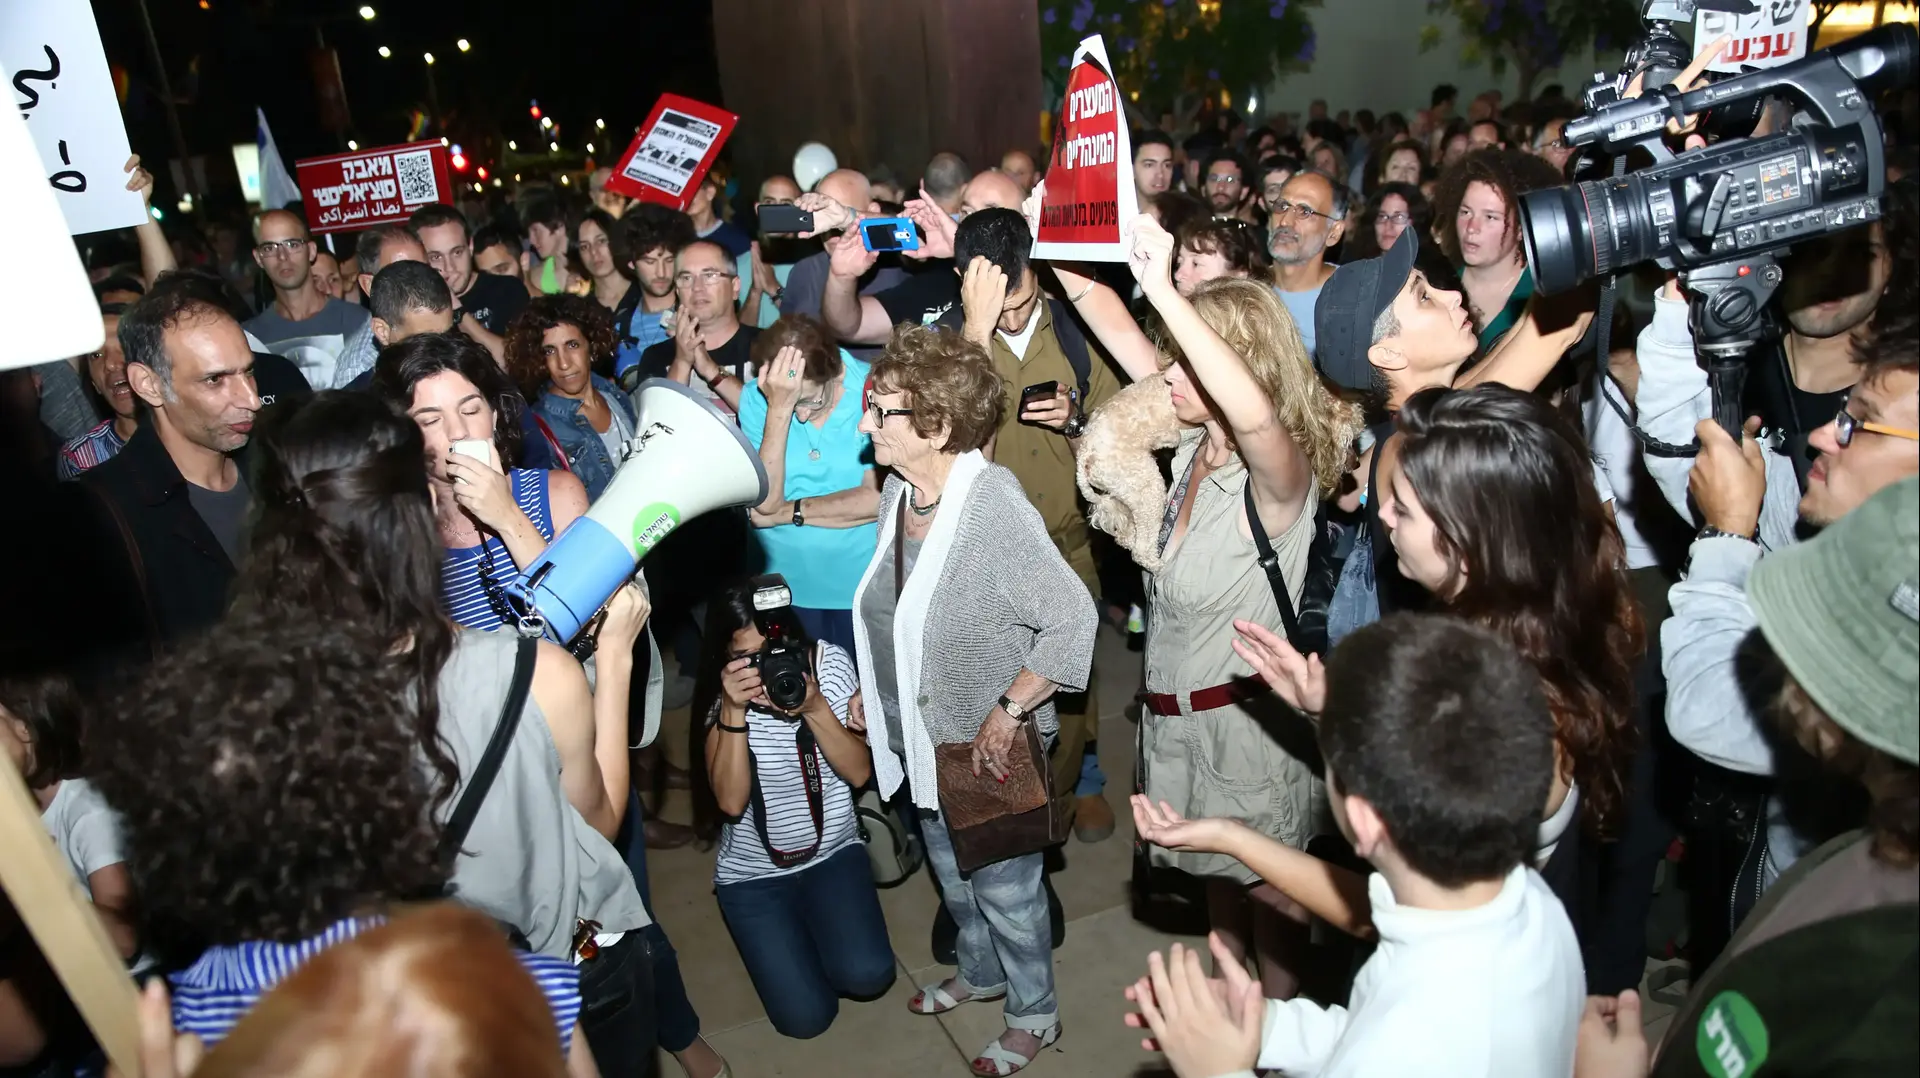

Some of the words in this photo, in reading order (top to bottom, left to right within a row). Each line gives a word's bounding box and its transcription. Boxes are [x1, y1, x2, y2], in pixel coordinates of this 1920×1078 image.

[1701, 31, 1797, 64] עכש
[1069, 80, 1114, 123] המעצרים
[1066, 131, 1115, 170] המינהליים
[341, 155, 394, 183] מאבק
[312, 178, 398, 207] סוציאליסטי
[318, 203, 369, 225] اشتراكي
[371, 201, 401, 217] نضال
[804, 753, 813, 777] EOS
[810, 777, 820, 794] 70D
